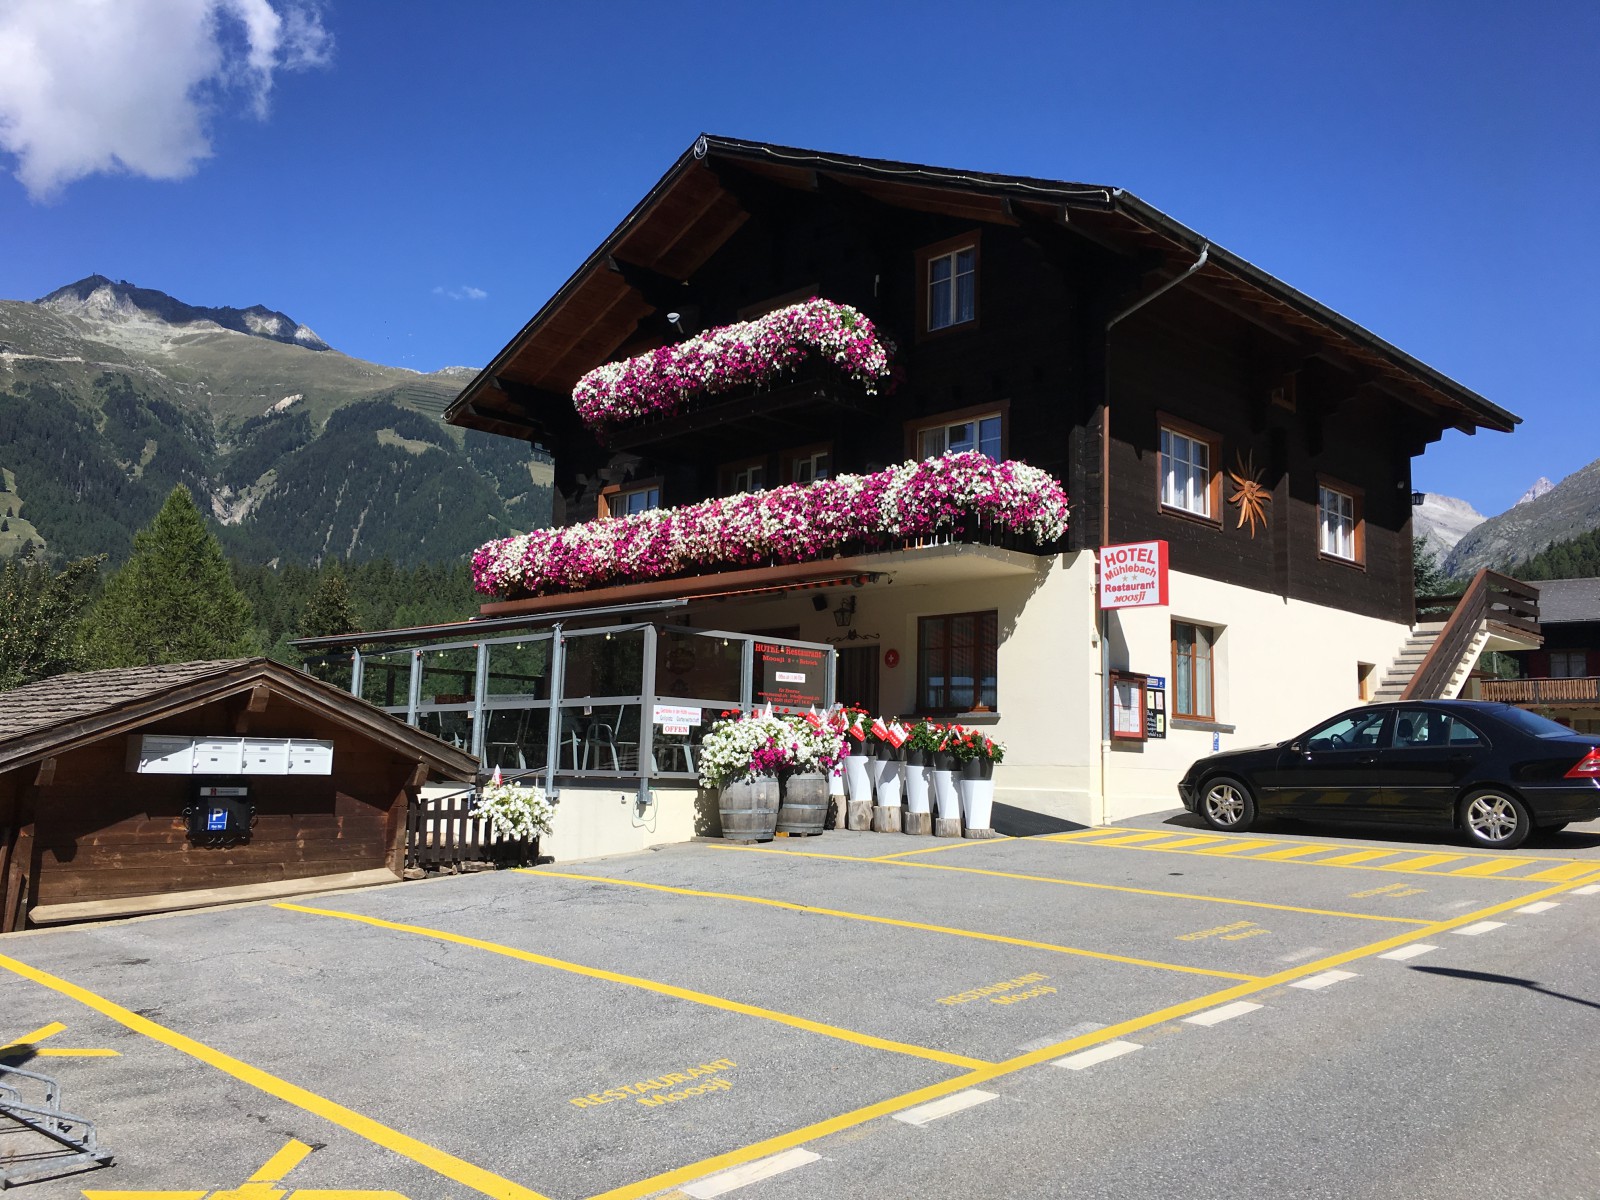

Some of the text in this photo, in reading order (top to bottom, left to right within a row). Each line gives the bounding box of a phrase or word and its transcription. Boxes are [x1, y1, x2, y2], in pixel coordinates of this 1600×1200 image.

[1104, 548, 1156, 568] HOTEL
[1104, 563, 1157, 581] Mühlebach
[1105, 581, 1155, 593] Restaurant
[664, 725, 688, 733] OFFEN
[212, 808, 224, 821] P
[569, 1058, 737, 1108] RESTAURANT
[637, 1078, 733, 1107] Moosji
